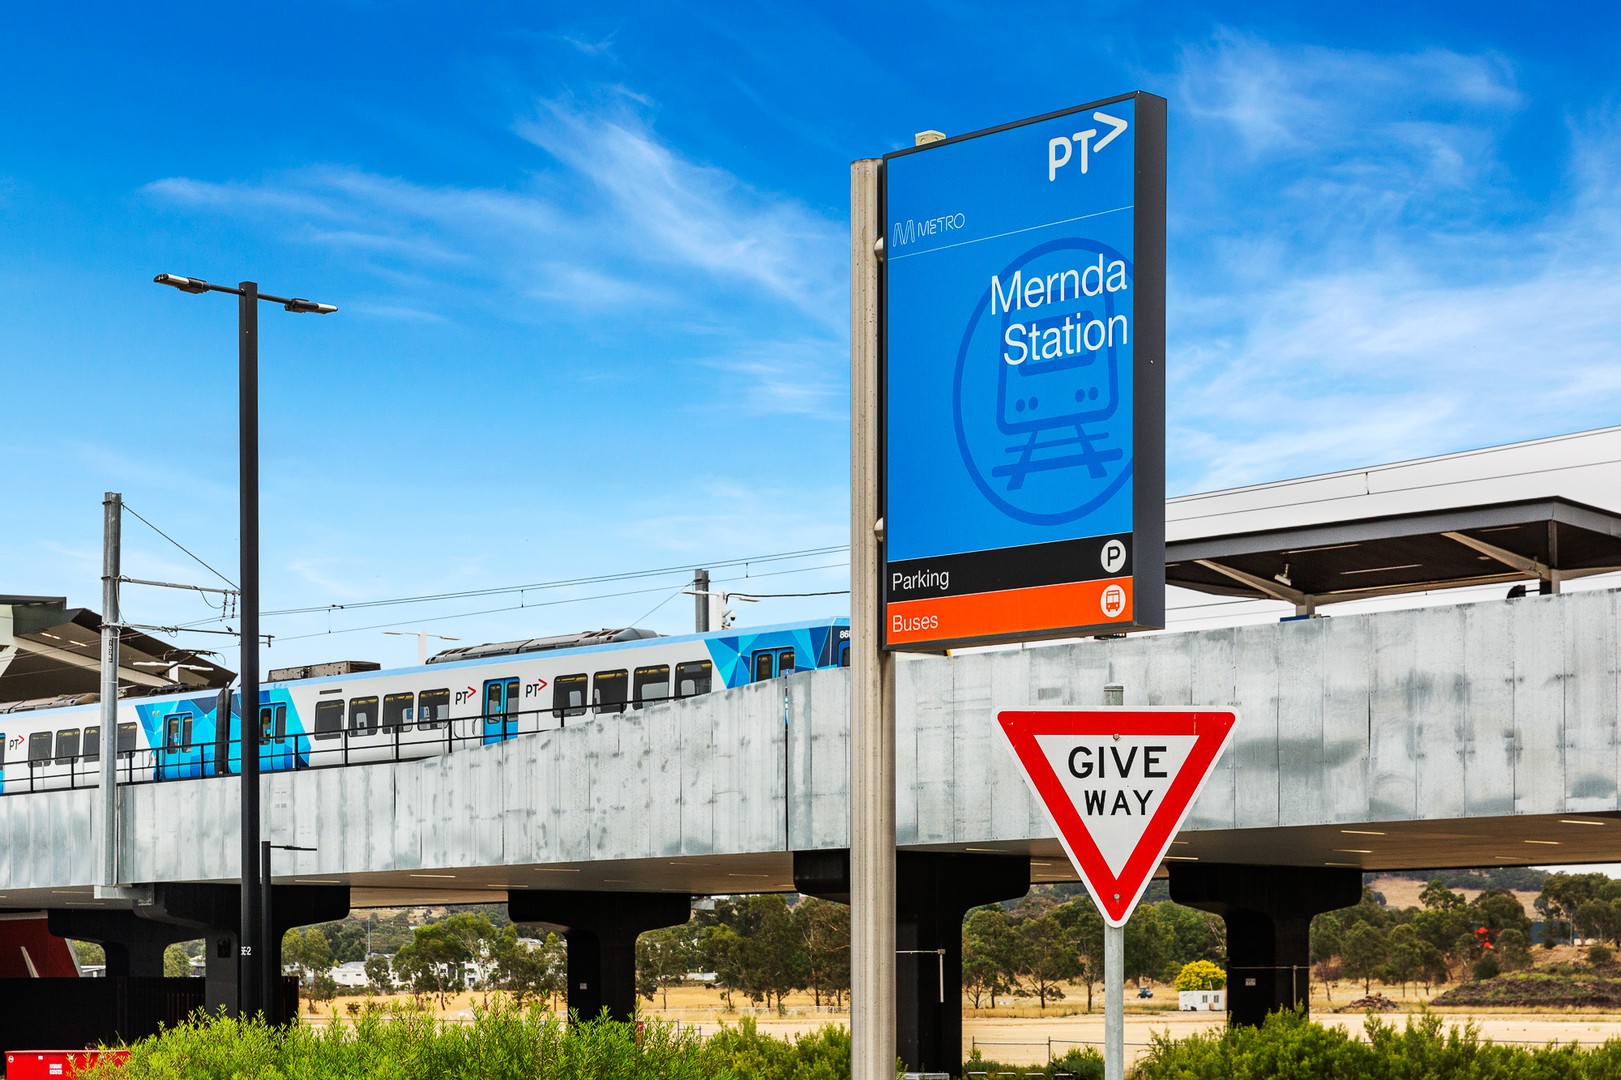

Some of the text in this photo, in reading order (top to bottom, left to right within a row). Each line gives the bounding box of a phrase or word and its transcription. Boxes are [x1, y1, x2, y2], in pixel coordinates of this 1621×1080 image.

[917, 212, 966, 237] METRO
[991, 253, 1128, 316] Mernda
[1003, 313, 1128, 366] Station
[892, 569, 950, 592] Parking
[892, 613, 939, 633] Buses
[1068, 746, 1168, 779] GIVE
[1084, 790, 1154, 816] WAY
